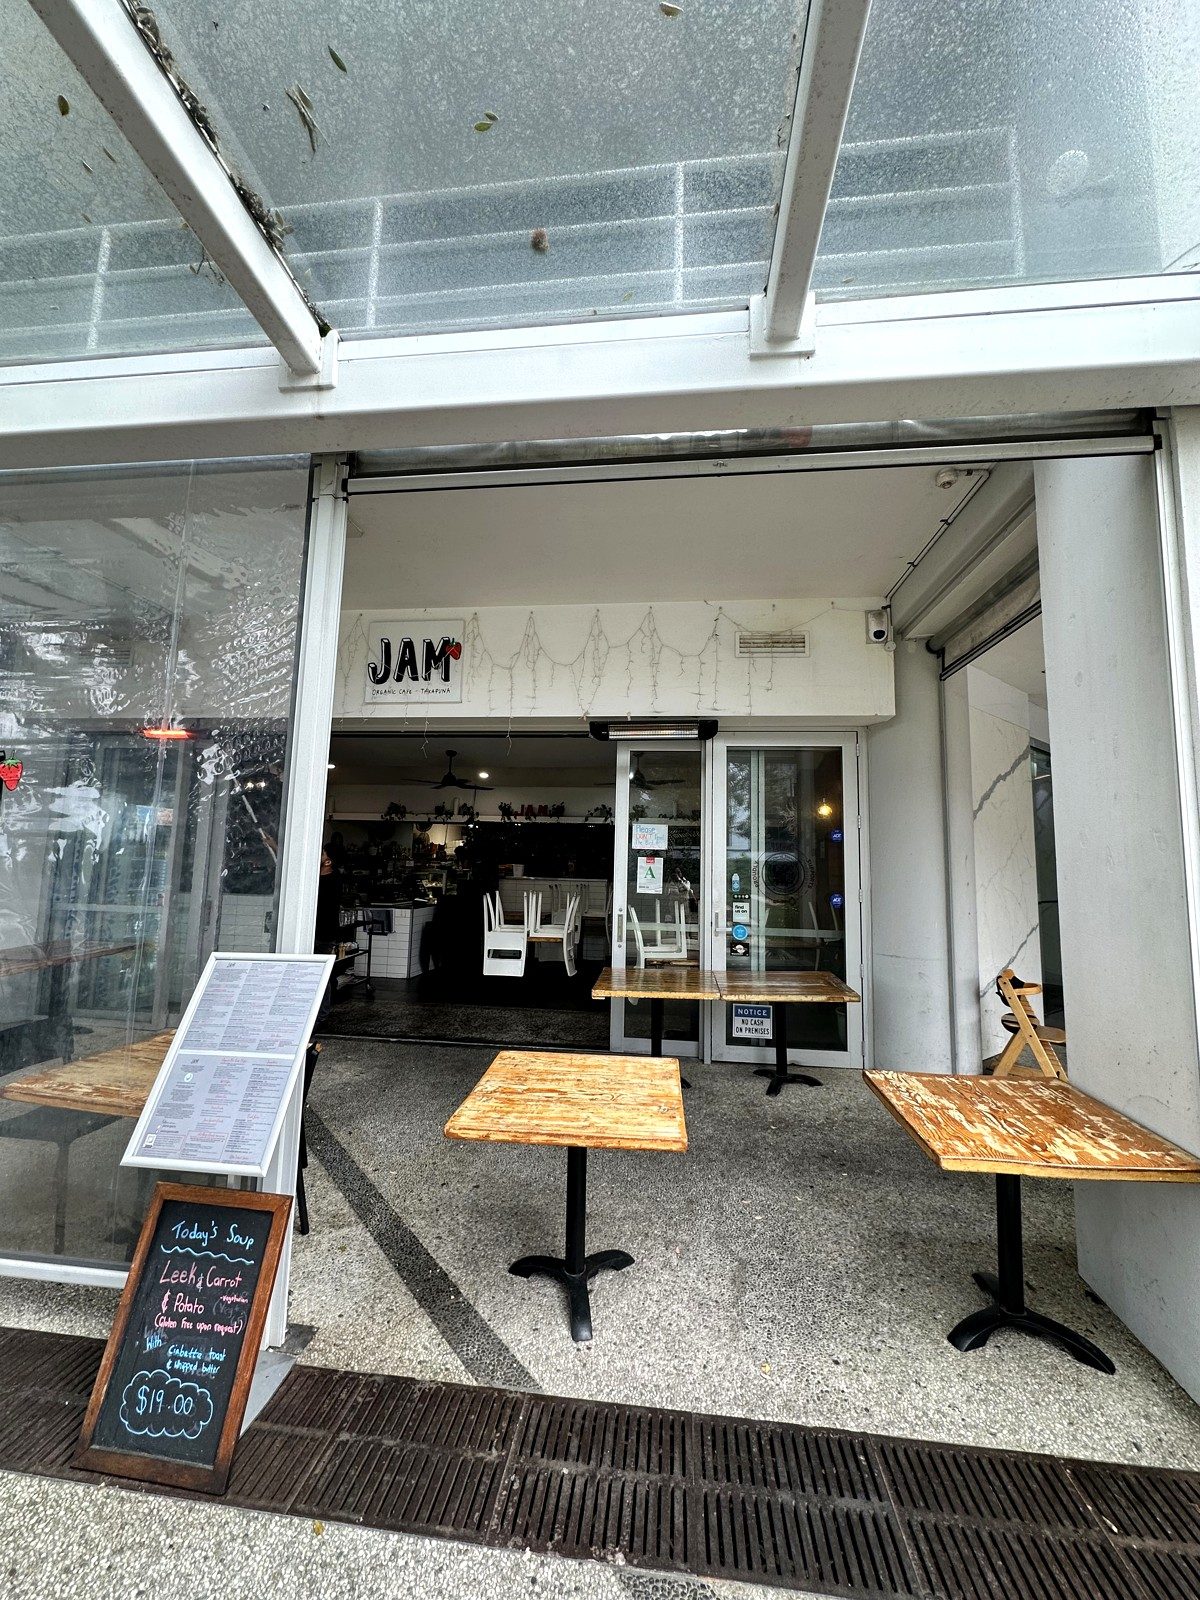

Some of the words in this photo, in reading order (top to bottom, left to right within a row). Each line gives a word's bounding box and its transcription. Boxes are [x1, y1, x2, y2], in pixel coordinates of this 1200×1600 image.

[367, 636, 451, 685] JAM
[371, 688, 396, 696] ORGANIC
[420, 687, 451, 695] TAKAPUNA
[515, 804, 549, 817] JAM
[643, 865, 656, 879] A
[737, 1008, 768, 1017] NOTICE
[741, 1018, 749, 1026] NO
[750, 1018, 764, 1027] CASH
[735, 1026, 743, 1034] ON
[744, 1026, 770, 1036] PREMISES
[171, 1220, 219, 1247] Today's
[226, 1223, 255, 1250] Soup
[159, 1259, 196, 1284] Leek
[206, 1265, 243, 1288] Carrot
[173, 1292, 205, 1315] Potato
[196, 1322, 212, 1334] upon
[213, 1319, 243, 1337] request)
[208, 1346, 227, 1362] toast
[201, 1362, 221, 1374] butter
[135, 1384, 194, 1416] $19.00
